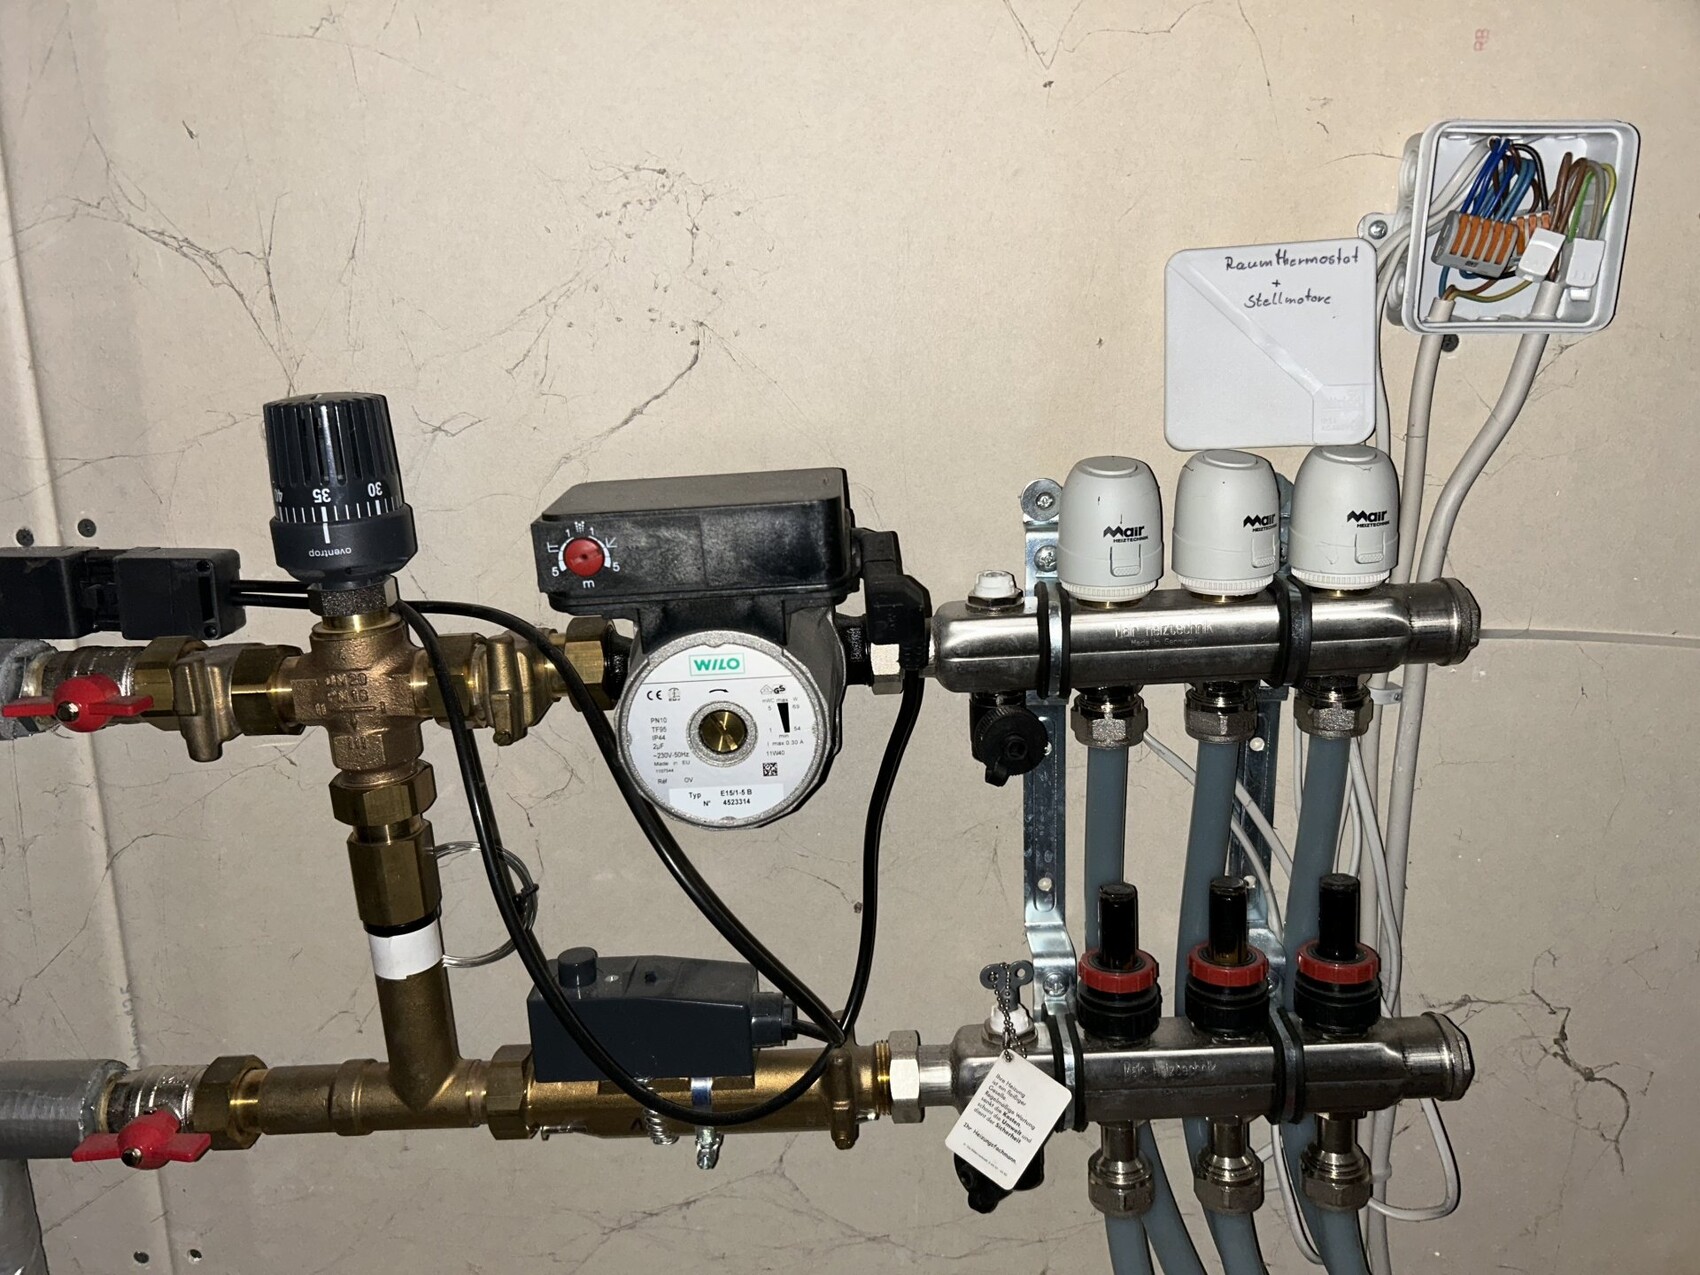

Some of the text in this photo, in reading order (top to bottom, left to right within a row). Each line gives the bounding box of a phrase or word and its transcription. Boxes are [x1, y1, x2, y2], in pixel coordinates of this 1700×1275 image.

[1244, 289, 1331, 308] Stellmotore
[313, 488, 331, 503] 35
[368, 482, 382, 497] 30
[1243, 514, 1275, 528] Mair
[1346, 510, 1387, 523] Mair
[566, 529, 570, 537] 1
[590, 527, 594, 535] 1
[1103, 525, 1145, 538] Mair
[309, 547, 352, 558] oventrop
[552, 567, 559, 576] 5
[612, 562, 620, 571] 5
[694, 658, 740, 671] WILO
[774, 685, 786, 694] GS
[996, 1073, 1025, 1098] Ihre Heizung
[981, 1097, 994, 1107] senkt
[994, 1106, 1002, 1114] die
[974, 1107, 986, 1118] dient
[986, 1116, 995, 1125] der
[978, 1102, 1032, 1143] schont die Umwelt und
[1016, 1112, 1035, 1131] Wartung
[963, 1122, 972, 1130] Ihr
